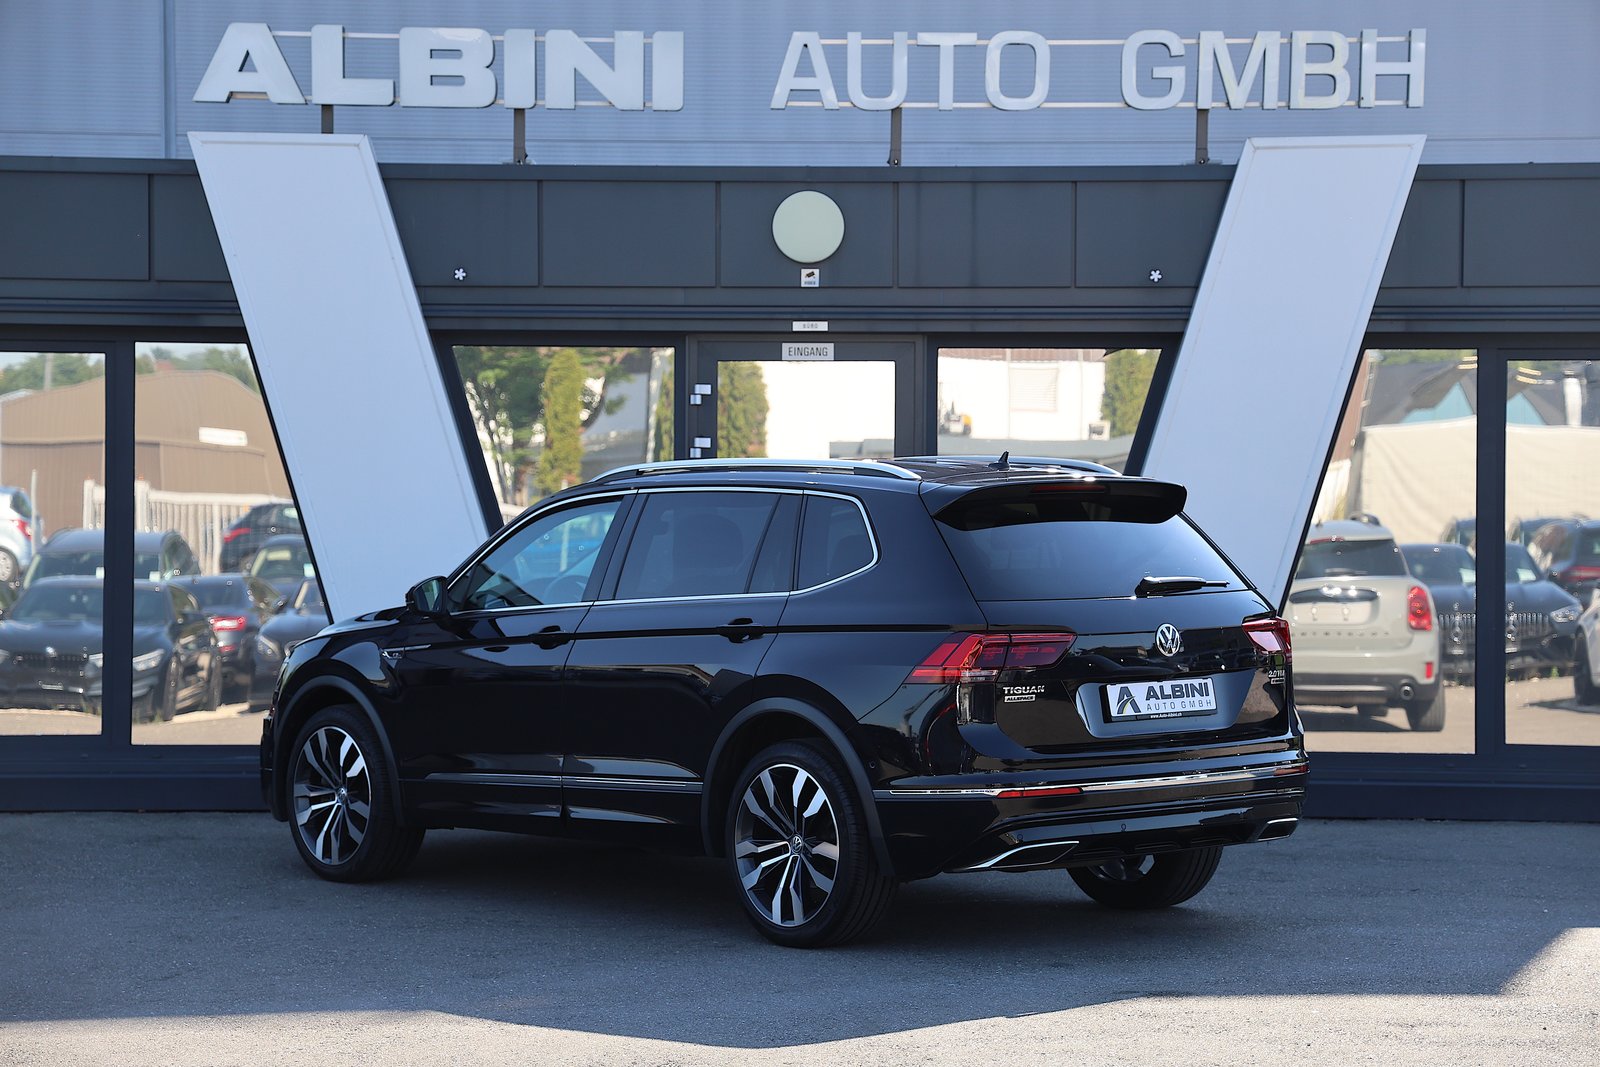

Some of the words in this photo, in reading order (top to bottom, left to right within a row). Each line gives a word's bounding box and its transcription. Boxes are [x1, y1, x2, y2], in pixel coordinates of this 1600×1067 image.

[192, 22, 684, 112] ALBINI
[771, 30, 1050, 112] AUTO
[1121, 28, 1427, 110] GMBH
[788, 346, 828, 357] EINGANG
[1003, 685, 1045, 694] TIGUAN
[1145, 682, 1210, 701] ALBINI
[1146, 701, 1176, 711] AUTO
[1181, 699, 1213, 709] GMBH
